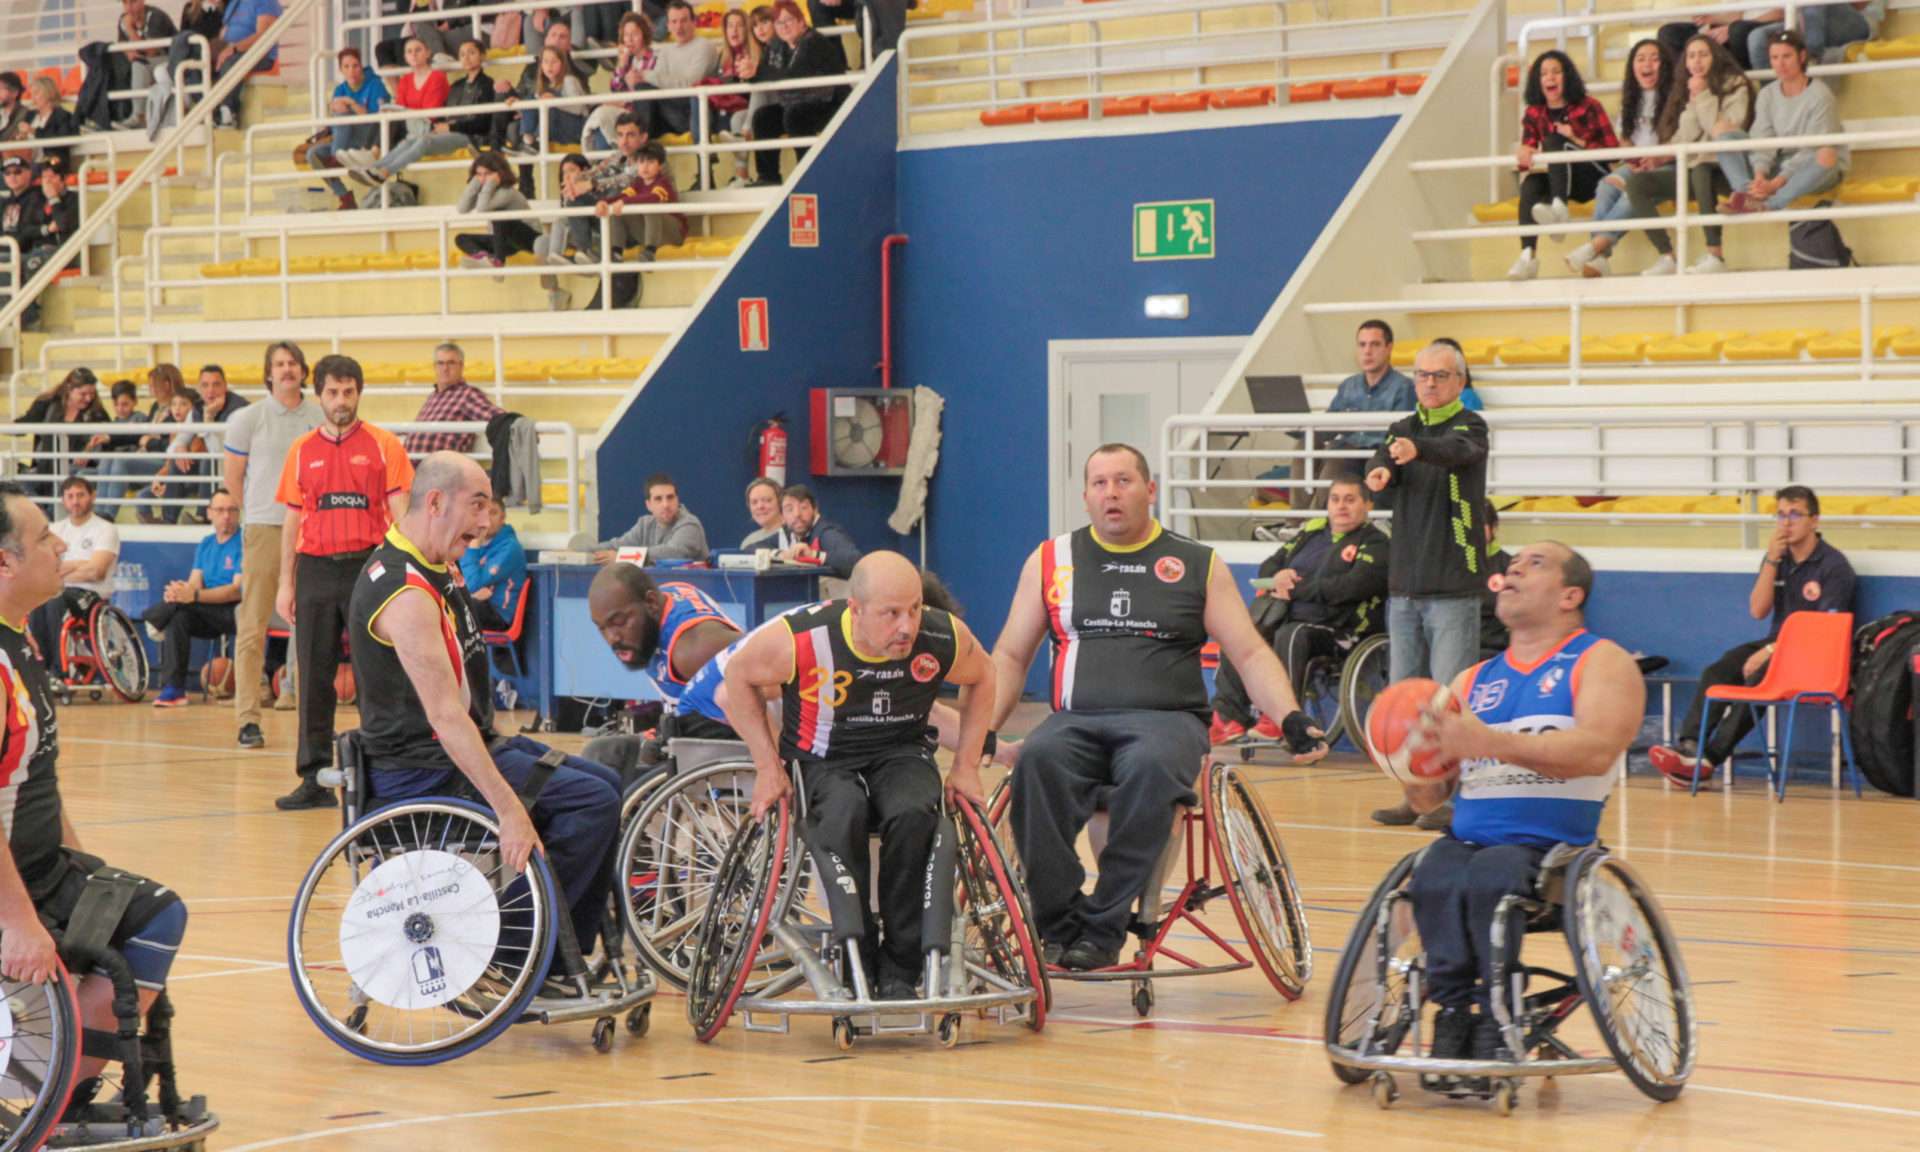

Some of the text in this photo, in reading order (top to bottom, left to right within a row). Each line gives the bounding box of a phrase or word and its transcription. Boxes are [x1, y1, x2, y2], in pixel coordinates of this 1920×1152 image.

[1083, 618, 1157, 629] Castilla-La Mancha
[799, 667, 853, 707] 23
[366, 902, 404, 919] Mancha
